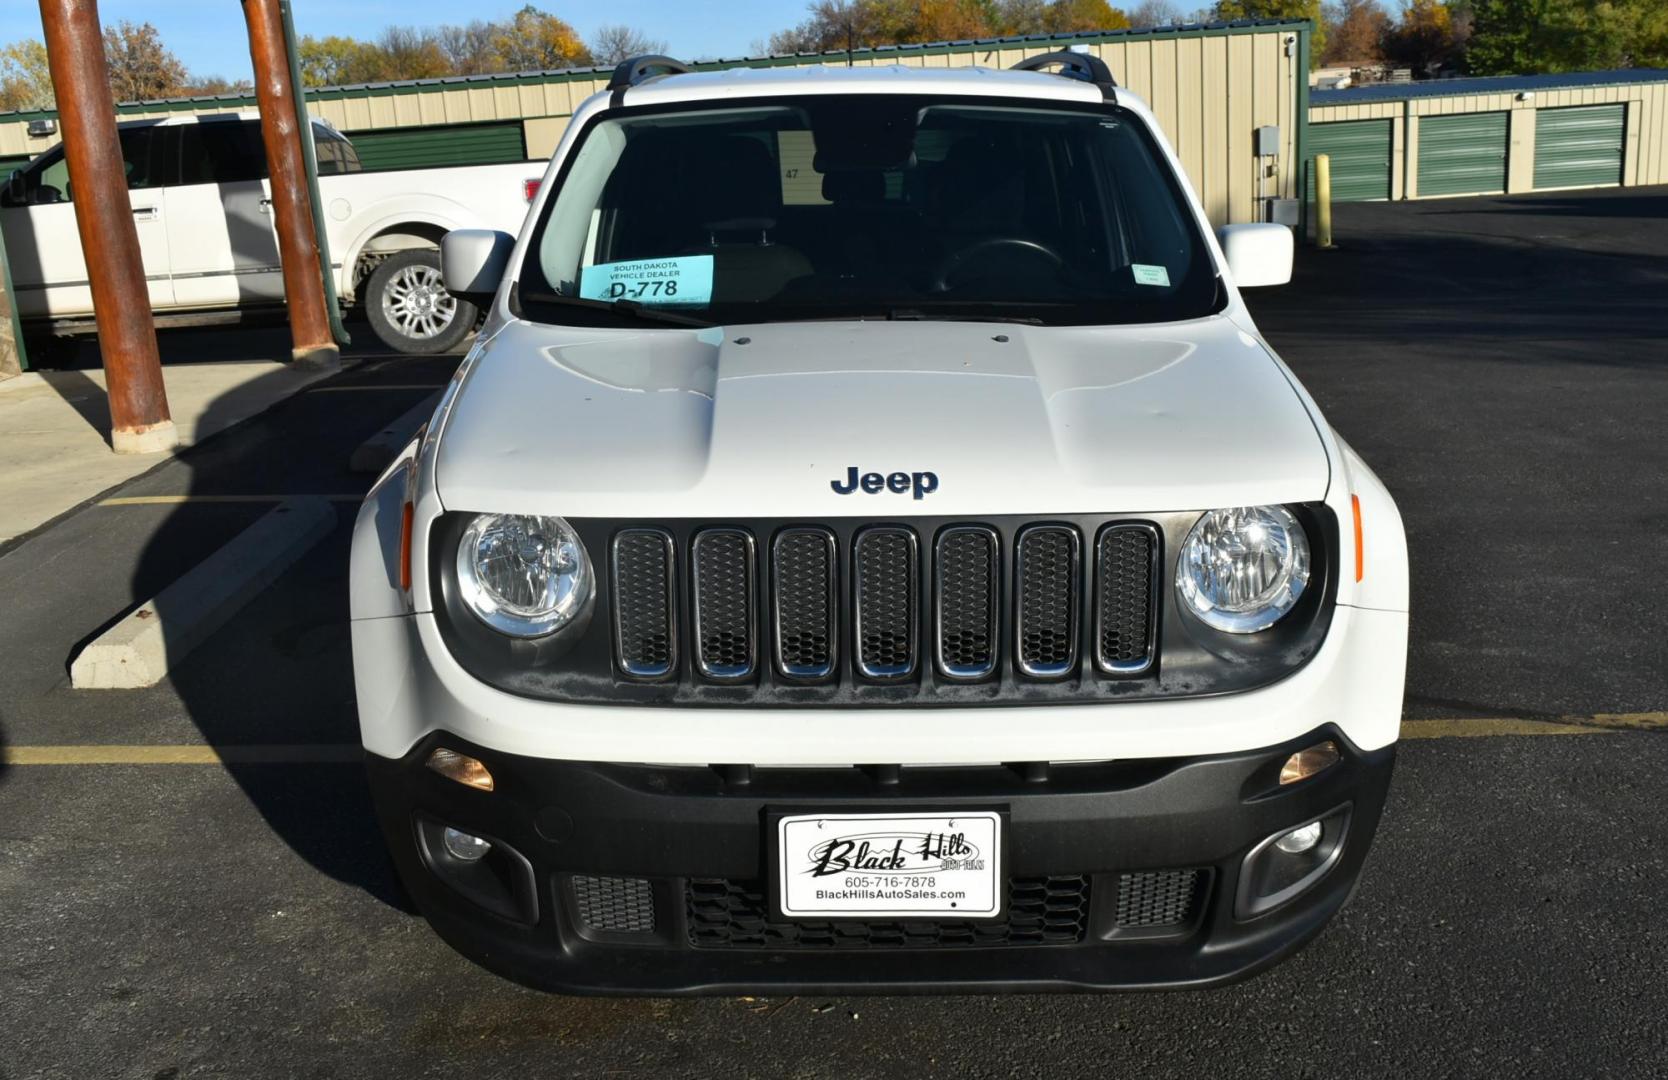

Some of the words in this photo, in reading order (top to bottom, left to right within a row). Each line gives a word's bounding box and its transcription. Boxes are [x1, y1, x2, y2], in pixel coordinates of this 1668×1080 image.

[785, 169, 798, 178] 47
[614, 264, 642, 272] SOUTH
[644, 262, 678, 270] DAKOTA
[609, 272, 645, 280] VEHICLE
[647, 270, 680, 279] DEALER
[610, 280, 678, 298] D-778
[830, 466, 939, 500] Jeep
[802, 838, 906, 877] Black
[917, 832, 972, 861] Hills
[845, 876, 936, 888] 605-716-7878
[815, 889, 966, 900] BlackHillsAutoSales.com
